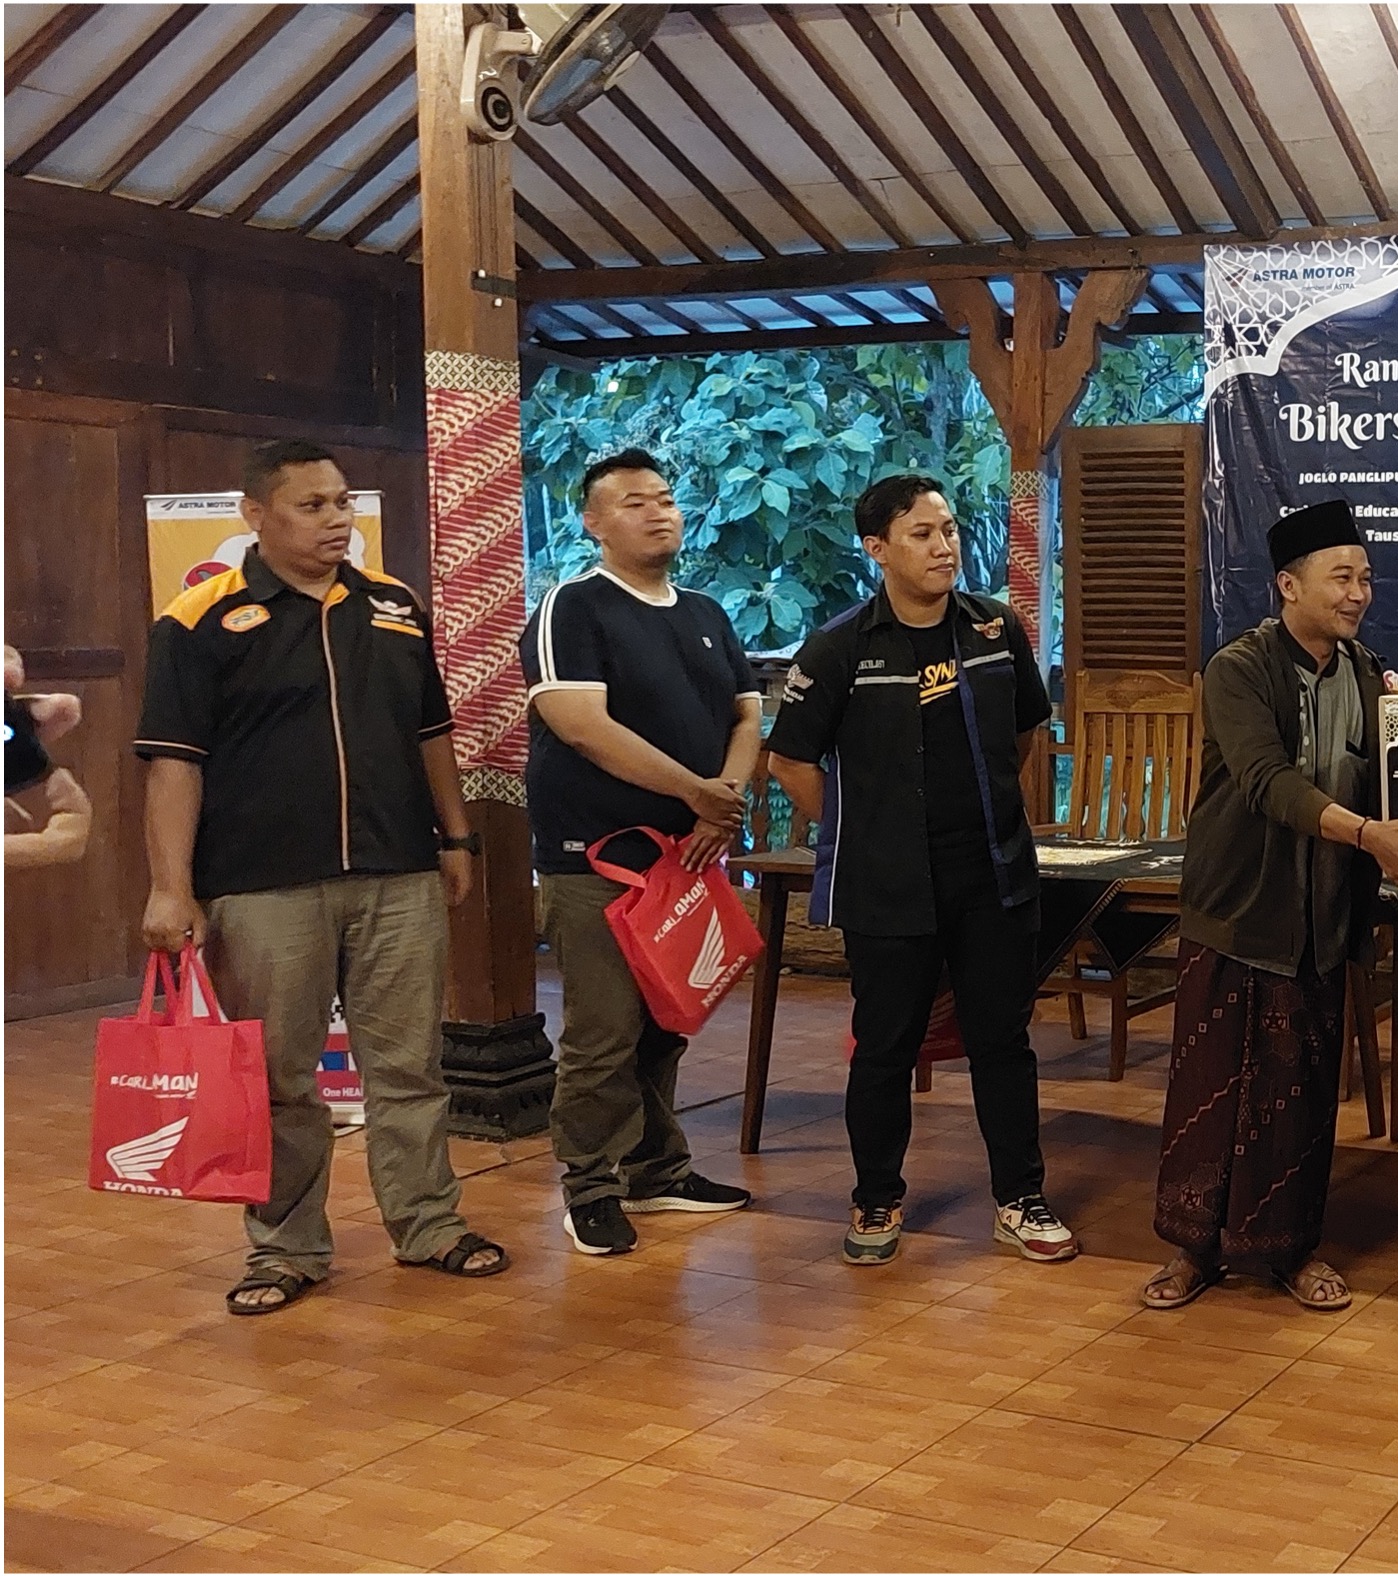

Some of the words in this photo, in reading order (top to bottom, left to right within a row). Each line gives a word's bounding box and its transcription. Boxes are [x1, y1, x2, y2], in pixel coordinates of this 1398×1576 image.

[1253, 269, 1299, 283] ASTRA
[1302, 266, 1356, 280] MOTOR
[1333, 282, 1356, 290] ASTRA
[1299, 472, 1337, 485] JOGLO
[701, 954, 749, 1008] HONDA
[322, 1087, 341, 1097] One
[342, 1087, 364, 1097] HEA
